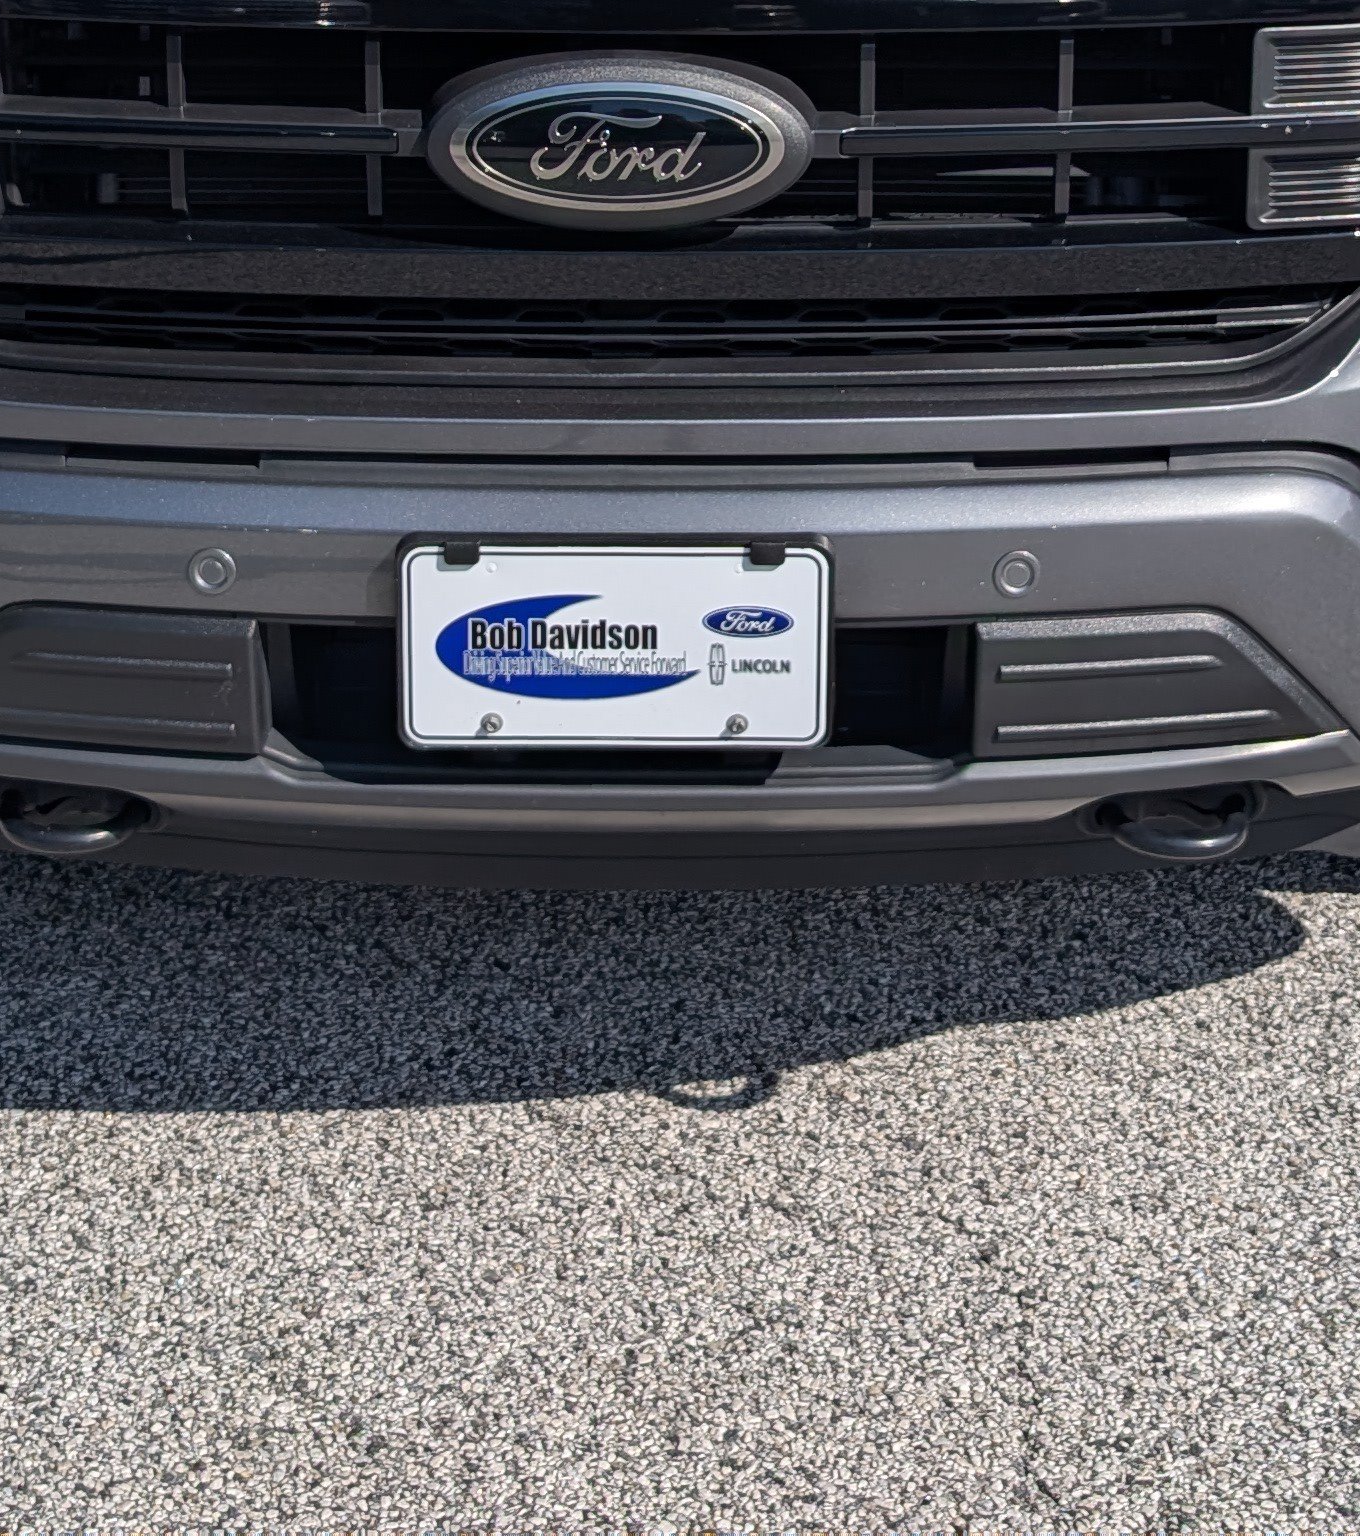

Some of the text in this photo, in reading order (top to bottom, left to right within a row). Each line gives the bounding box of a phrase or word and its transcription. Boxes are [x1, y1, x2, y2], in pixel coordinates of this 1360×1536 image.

[529, 111, 707, 181] Ford
[470, 618, 658, 650] Bob Davidson
[720, 610, 776, 632] Ford
[731, 658, 791, 673] LINCOLN
